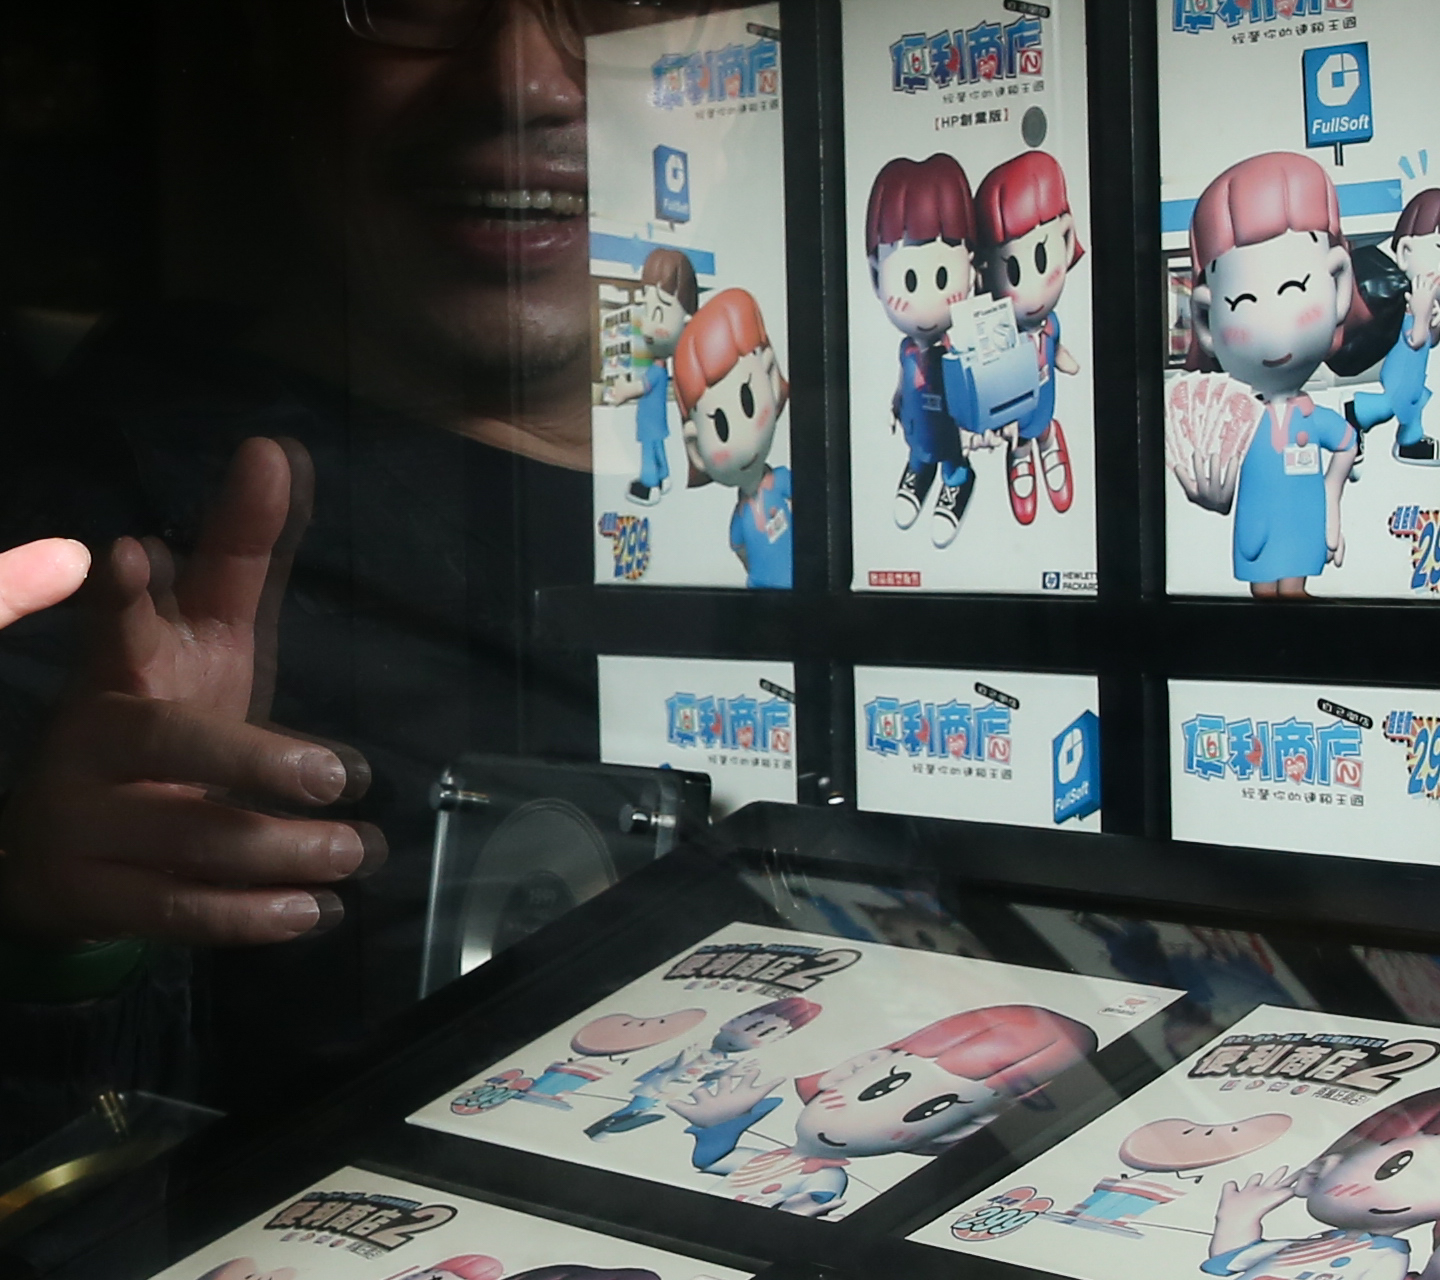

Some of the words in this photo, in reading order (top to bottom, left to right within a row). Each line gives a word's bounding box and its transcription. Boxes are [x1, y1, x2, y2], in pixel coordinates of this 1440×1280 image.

[1312, 115, 1370, 135] FullSoft
[1054, 780, 1090, 813] FullSoft
[950, 1205, 1039, 1235] 299
